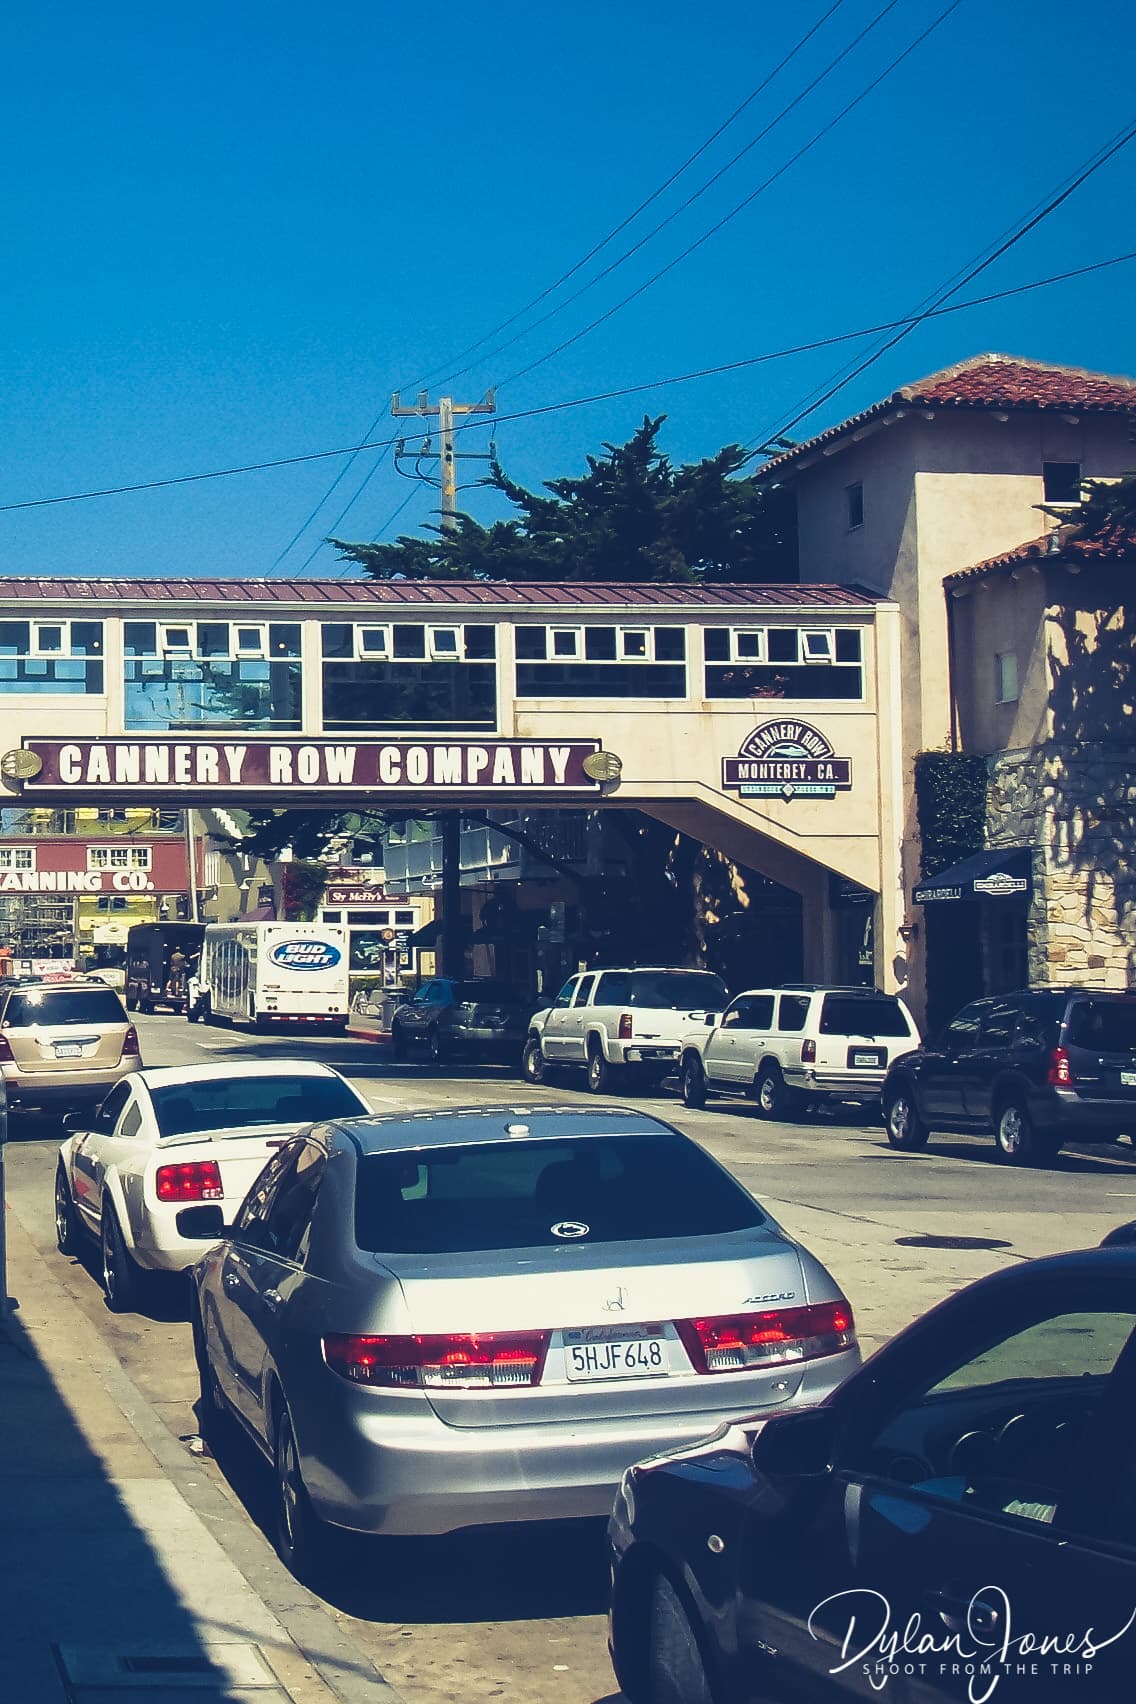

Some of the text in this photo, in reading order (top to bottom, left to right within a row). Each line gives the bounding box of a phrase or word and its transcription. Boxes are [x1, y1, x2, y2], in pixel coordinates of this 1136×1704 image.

[748, 724, 828, 757] CANNERY ROW
[59, 744, 571, 784] CANNERY ROW COMPANY
[738, 763, 840, 781] MONTEREY, CA.
[111, 871, 155, 891] CO.
[275, 953, 333, 964] LIGHT
[285, 943, 327, 954] BUD
[572, 1341, 662, 1371] 5HJF648
